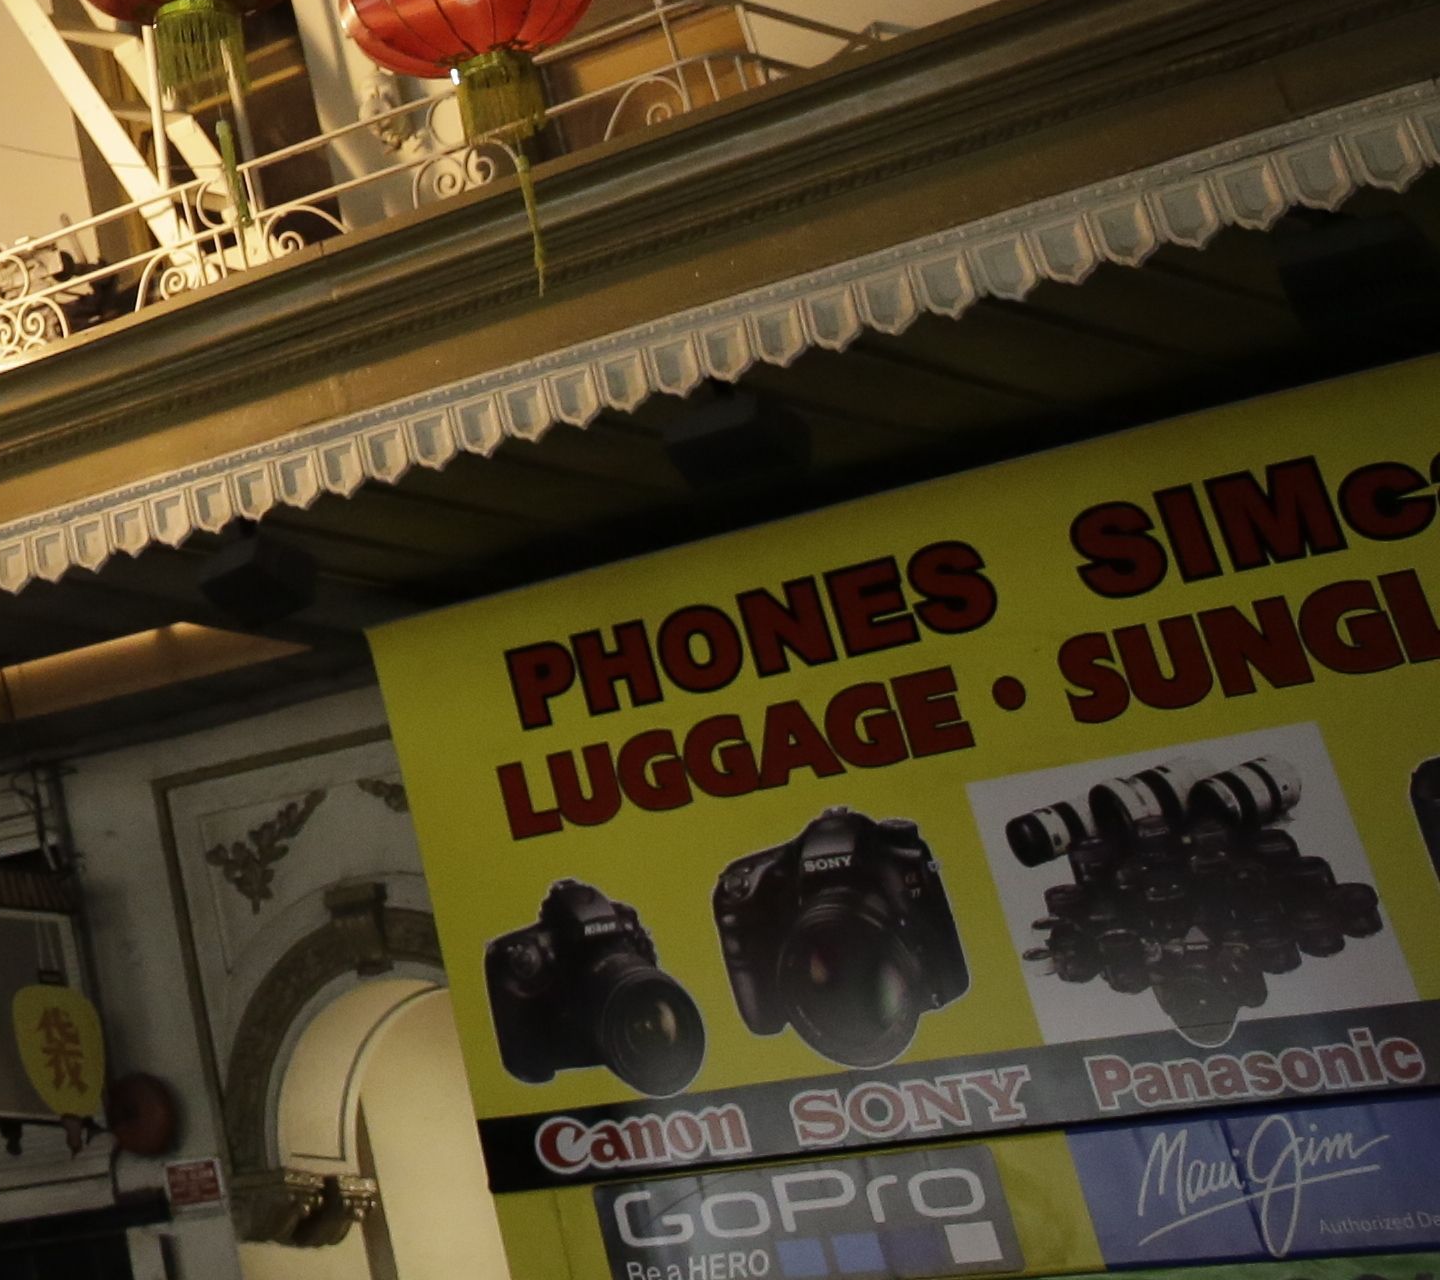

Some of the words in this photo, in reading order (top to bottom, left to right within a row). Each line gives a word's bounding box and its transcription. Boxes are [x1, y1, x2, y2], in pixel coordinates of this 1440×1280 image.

[505, 540, 997, 730] PHONES
[497, 665, 975, 840] LUGGAGE
[803, 853, 854, 874] SONY
[584, 920, 617, 937] Nikon
[787, 1064, 1031, 1149] SONY
[1083, 1027, 1426, 1112] Panasonic
[534, 1102, 753, 1176] Canon
[612, 1166, 987, 1249] GoPro
[1136, 1129, 1247, 1218] Maui
[1246, 1113, 1391, 1260] Jim
[1320, 1211, 1415, 1235] Authorized
[687, 1249, 771, 1280] HERO
